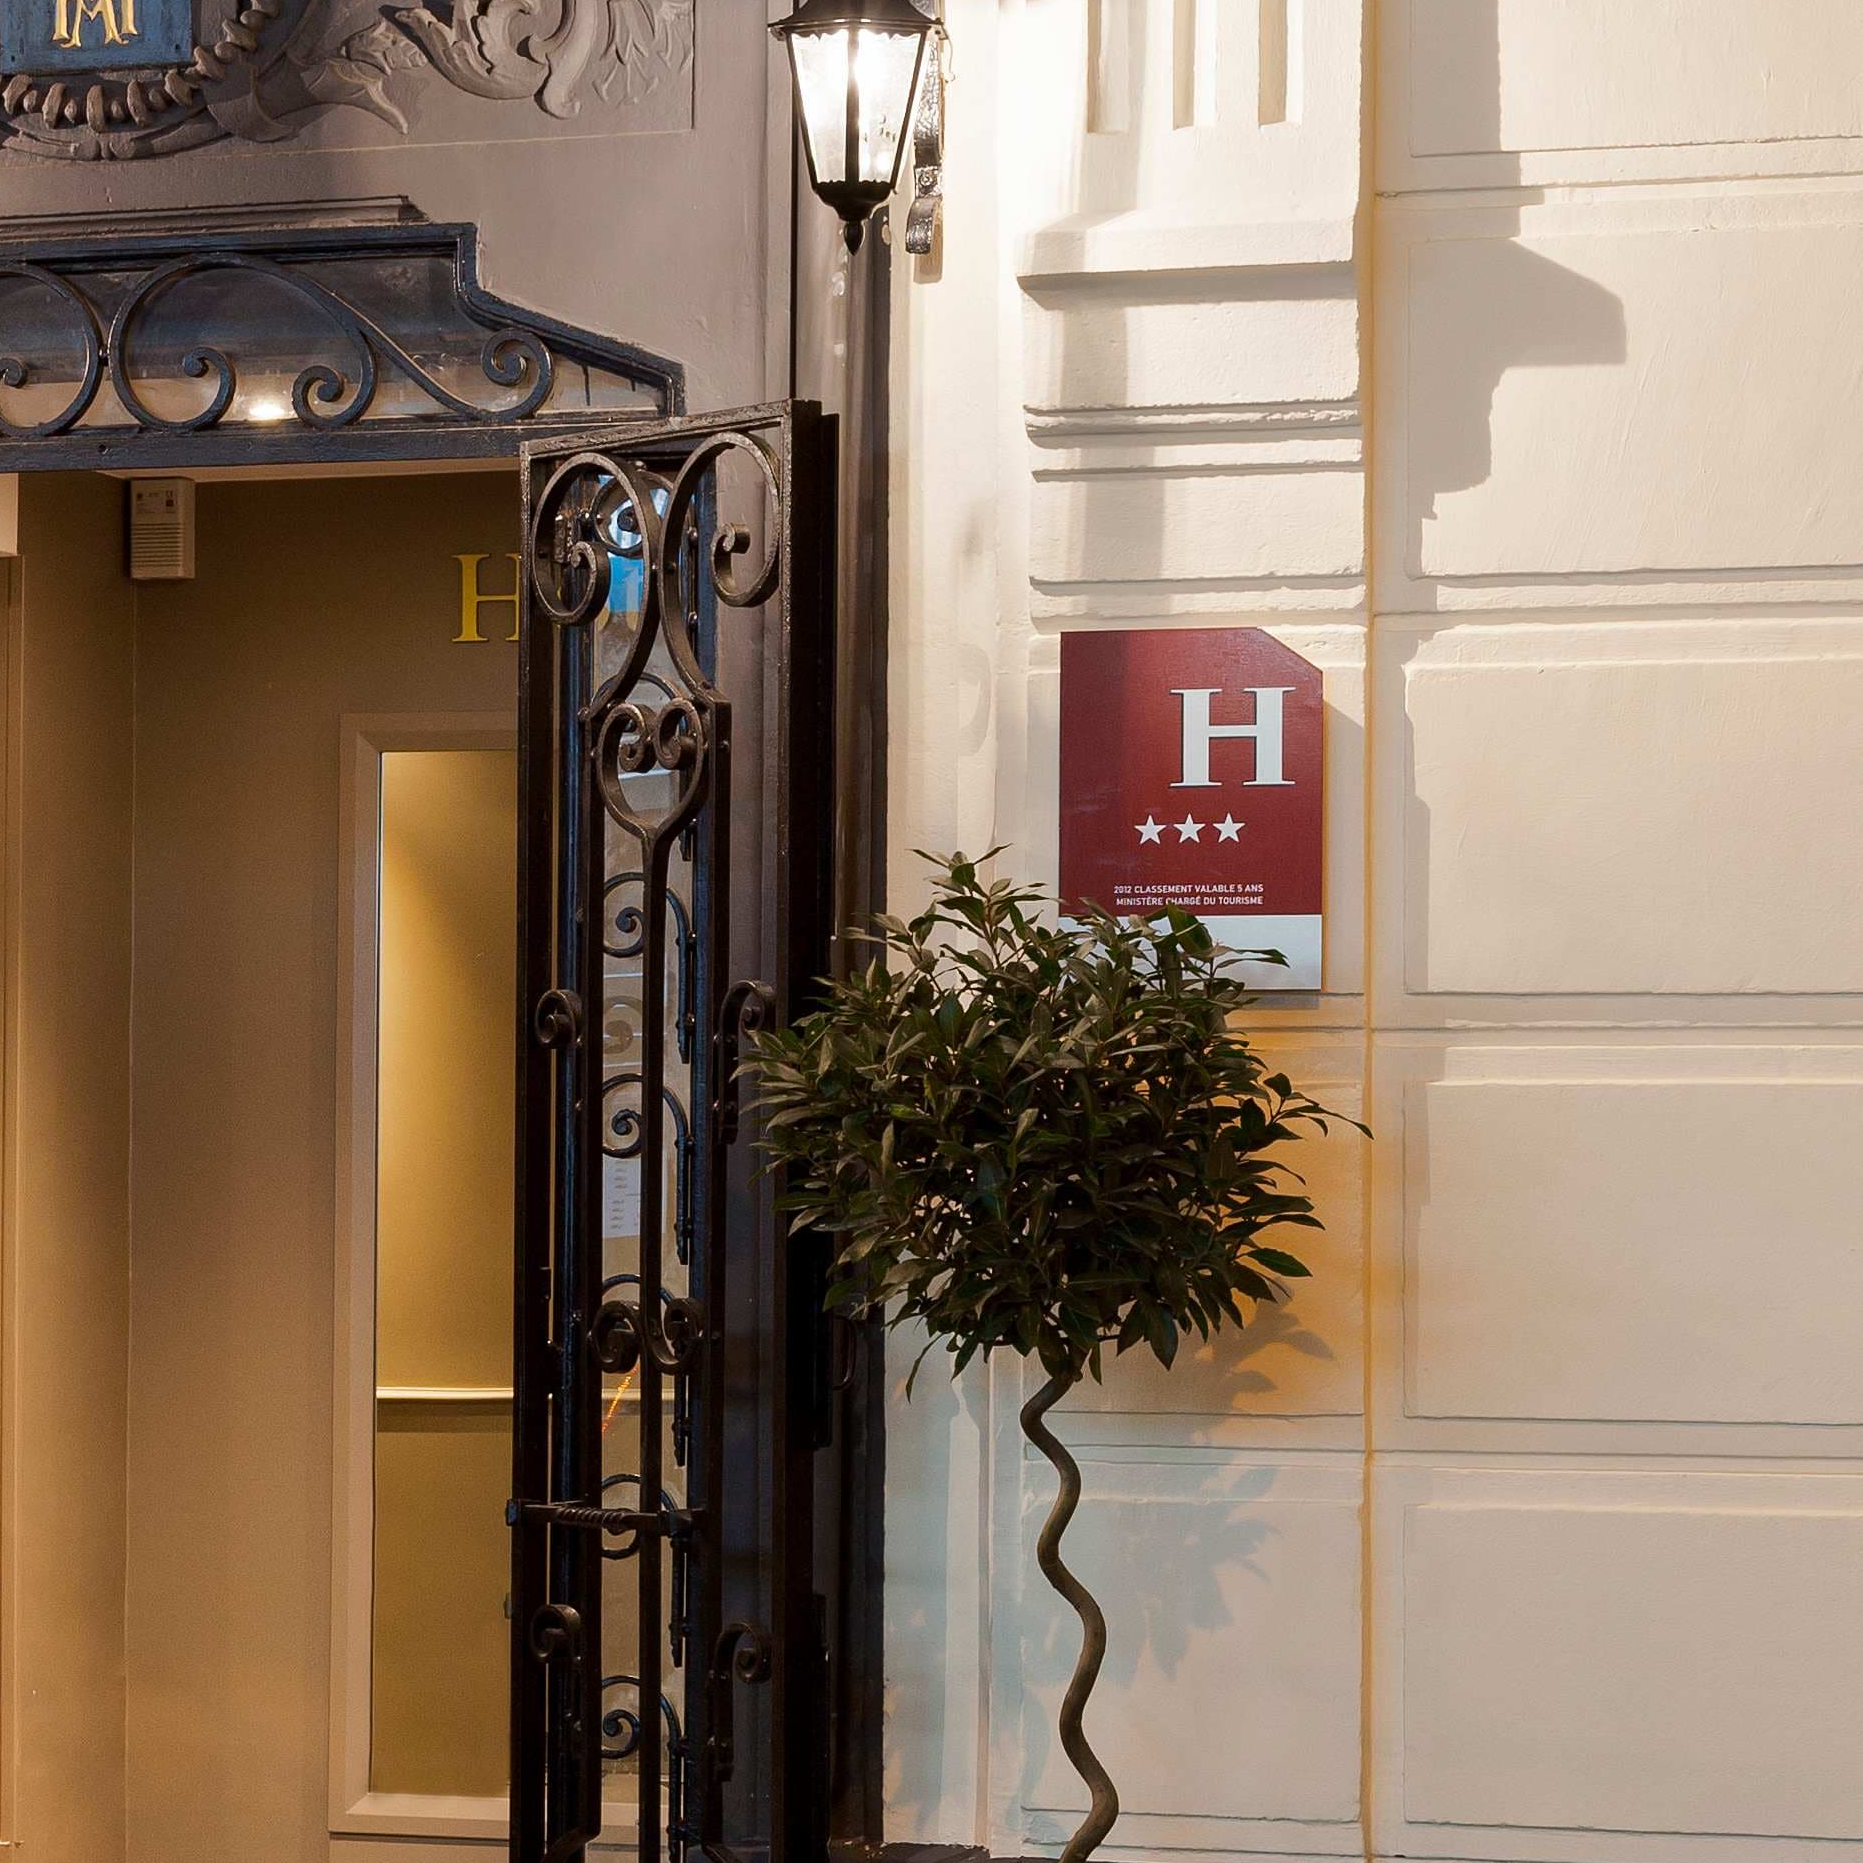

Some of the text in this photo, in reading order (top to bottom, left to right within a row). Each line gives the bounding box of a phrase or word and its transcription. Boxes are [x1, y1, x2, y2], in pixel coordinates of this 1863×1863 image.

[1169, 686, 1297, 788] H
[1134, 884, 1193, 894] CLASSEMENT
[1194, 883, 1236, 893] VALABLE
[1237, 883, 1243, 893] 5
[1244, 883, 1264, 893] ANS
[1203, 896, 1216, 906] DU
[1218, 895, 1264, 906] TOURISME
